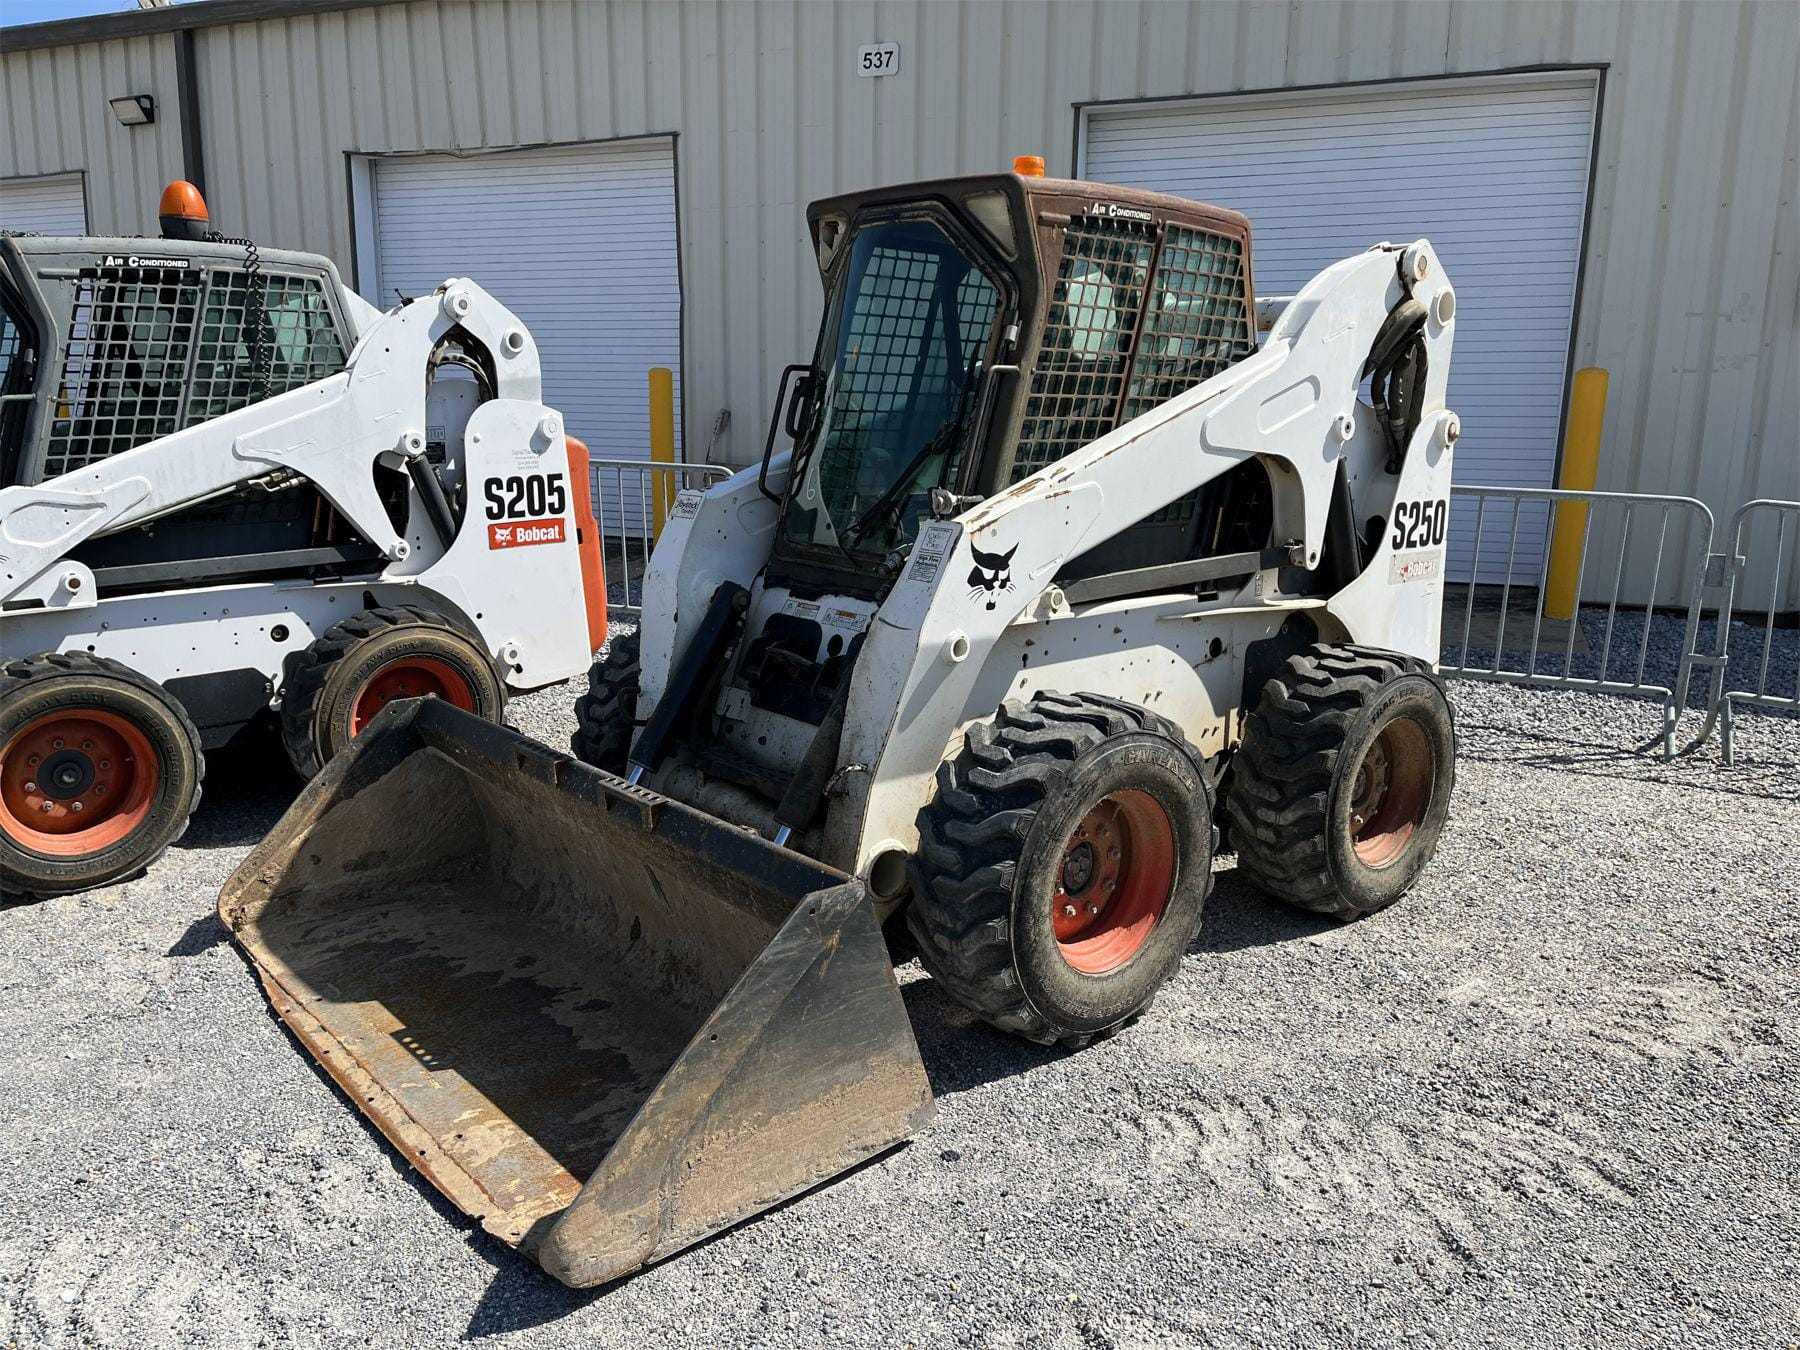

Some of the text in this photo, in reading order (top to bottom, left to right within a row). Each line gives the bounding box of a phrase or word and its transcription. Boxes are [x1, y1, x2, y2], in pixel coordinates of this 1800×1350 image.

[862, 50, 894, 70] 537
[484, 473, 566, 520] S205
[516, 525, 560, 543] Bobcat
[1392, 499, 1446, 550] S250
